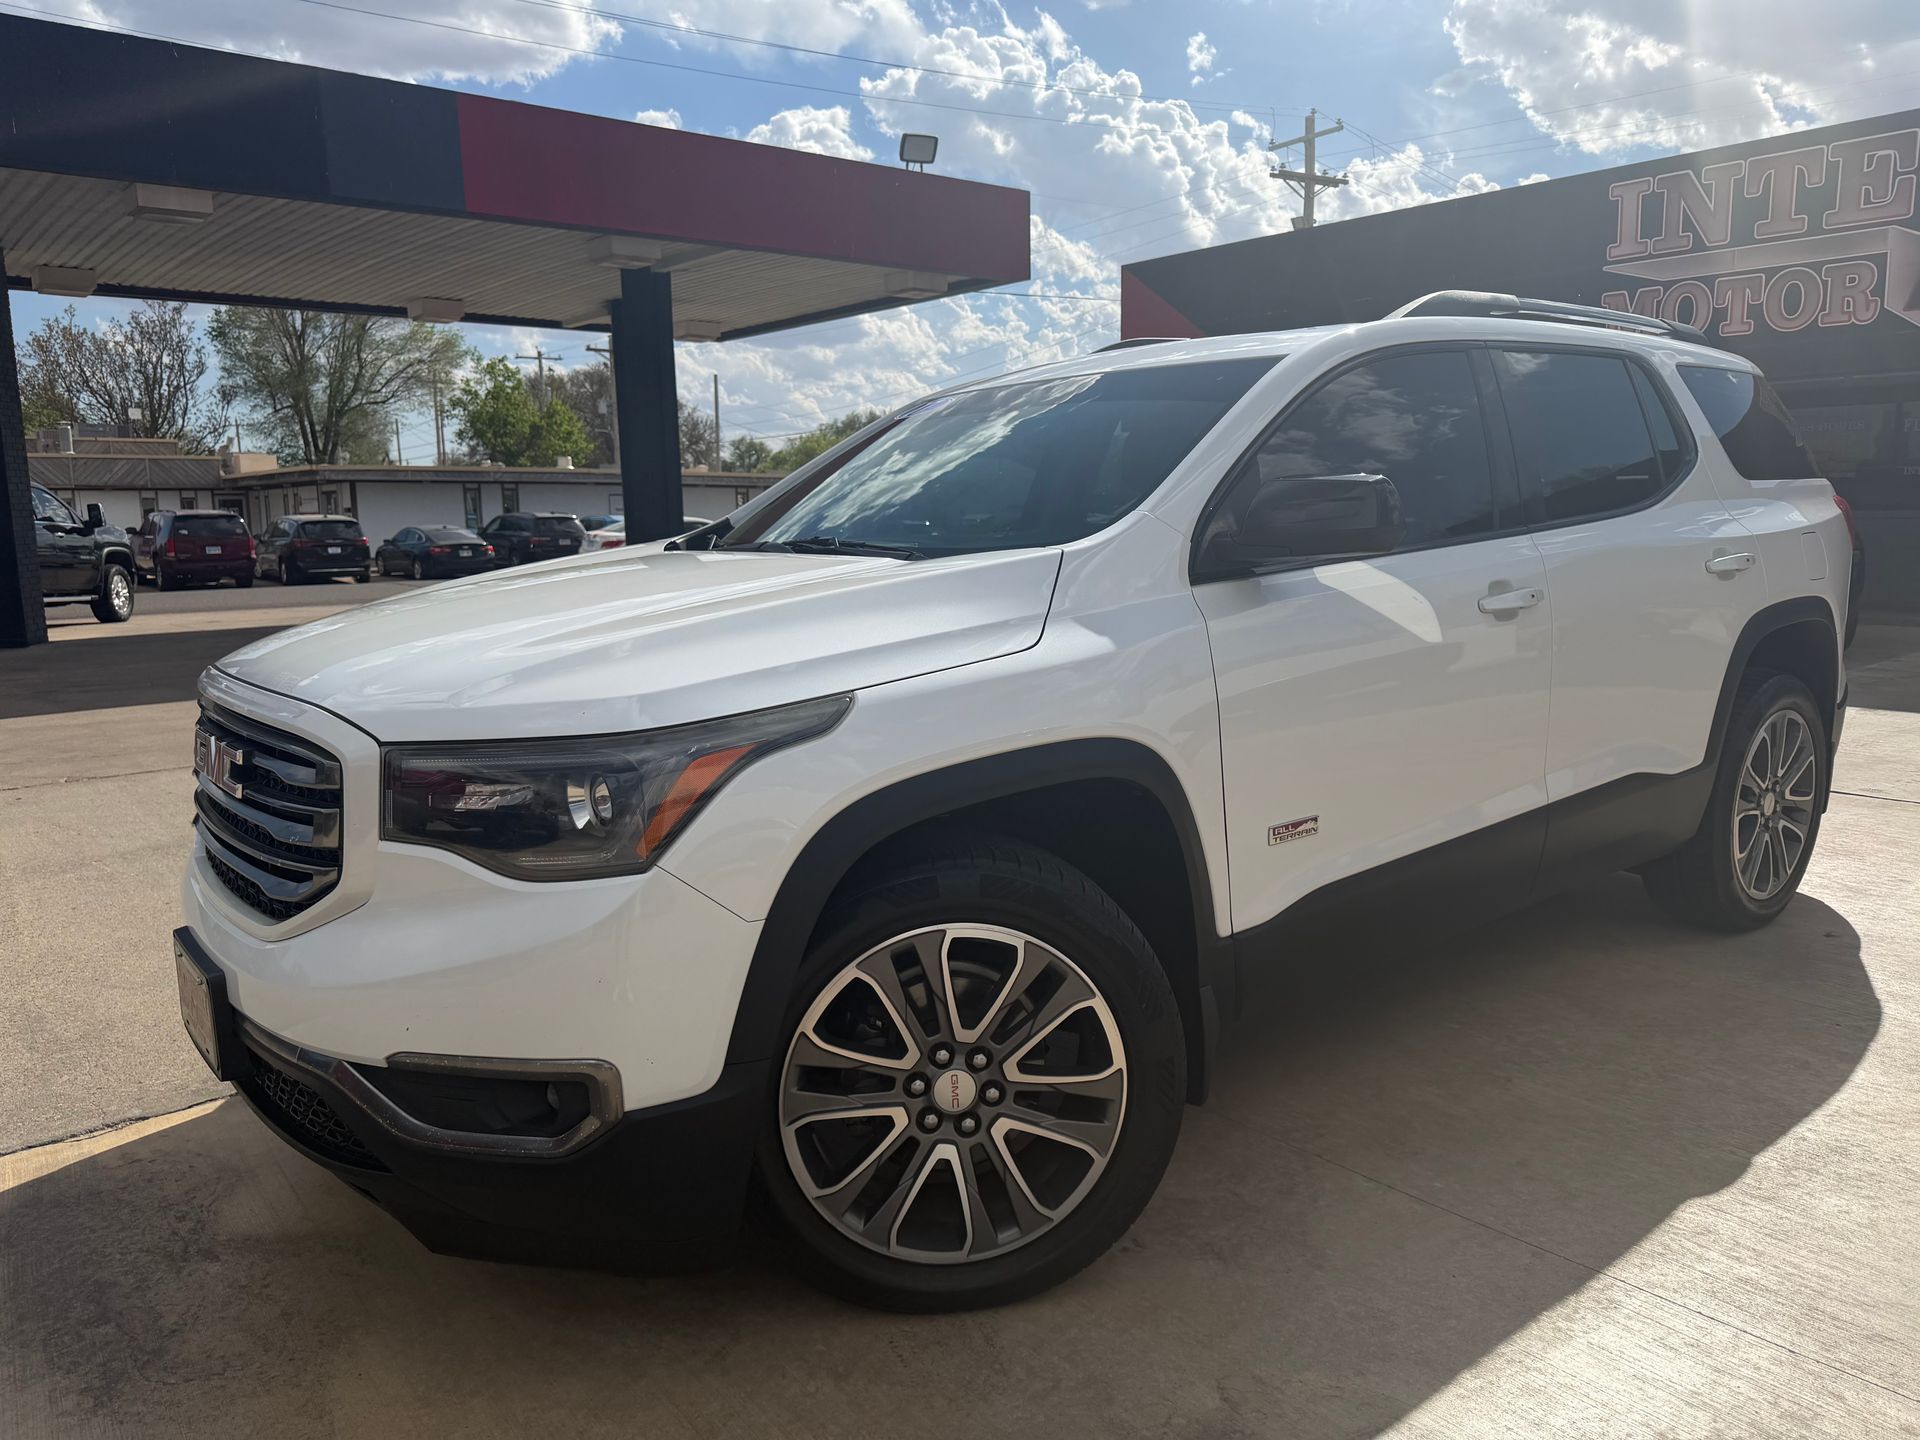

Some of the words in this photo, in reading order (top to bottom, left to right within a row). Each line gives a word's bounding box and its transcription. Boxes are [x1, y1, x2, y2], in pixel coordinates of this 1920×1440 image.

[1606, 128, 1920, 261] INTE
[1601, 260, 1881, 337] MOTOR
[194, 727, 243, 800] GMC
[1272, 826, 1319, 843] TERRAIN
[1274, 824, 1296, 836] ALL
[950, 1073, 960, 1110] GMC
